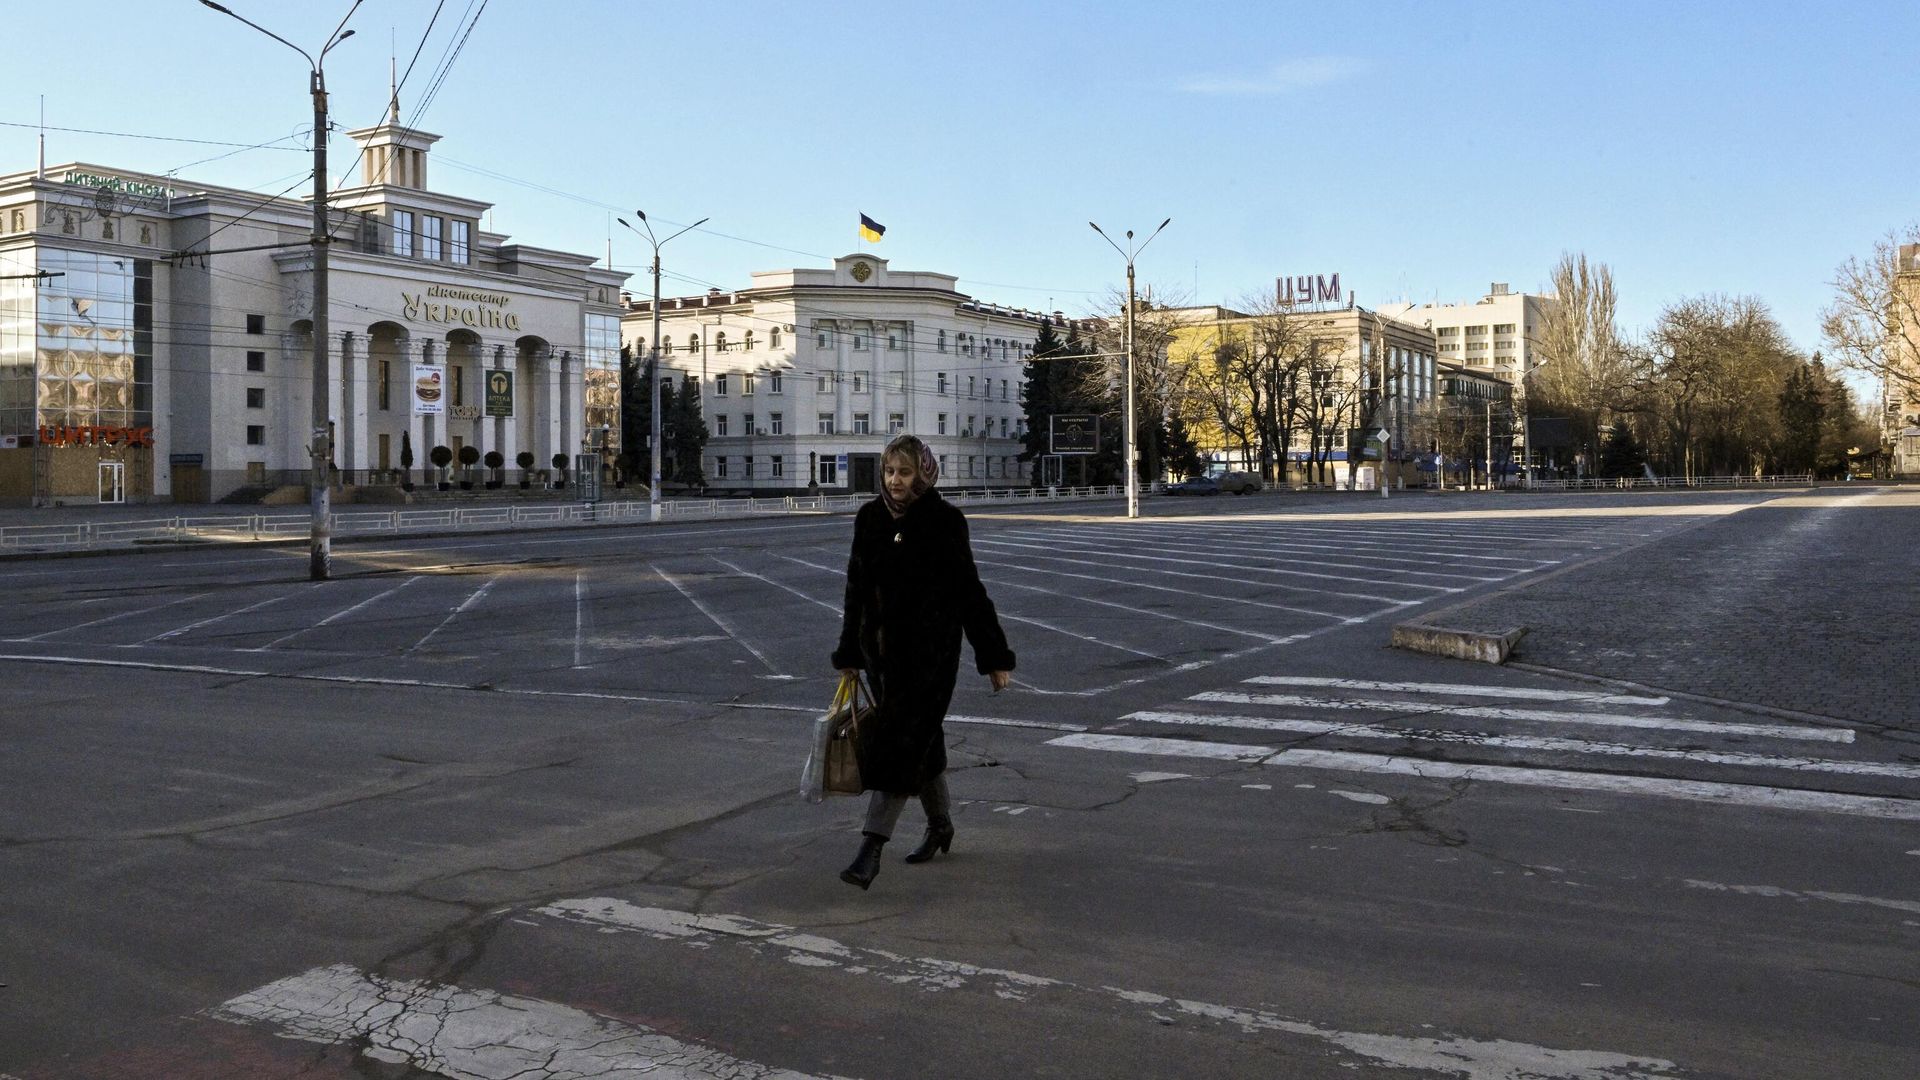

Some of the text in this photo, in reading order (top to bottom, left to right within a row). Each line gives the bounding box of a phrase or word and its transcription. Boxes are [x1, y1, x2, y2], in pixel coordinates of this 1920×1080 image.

[64, 171, 120, 191] ДИТЯЧИЙ
[1276, 273, 1339, 305] ЦУМ
[401, 292, 521, 332] Україна
[39, 424, 154, 447] ЦИТРУС
